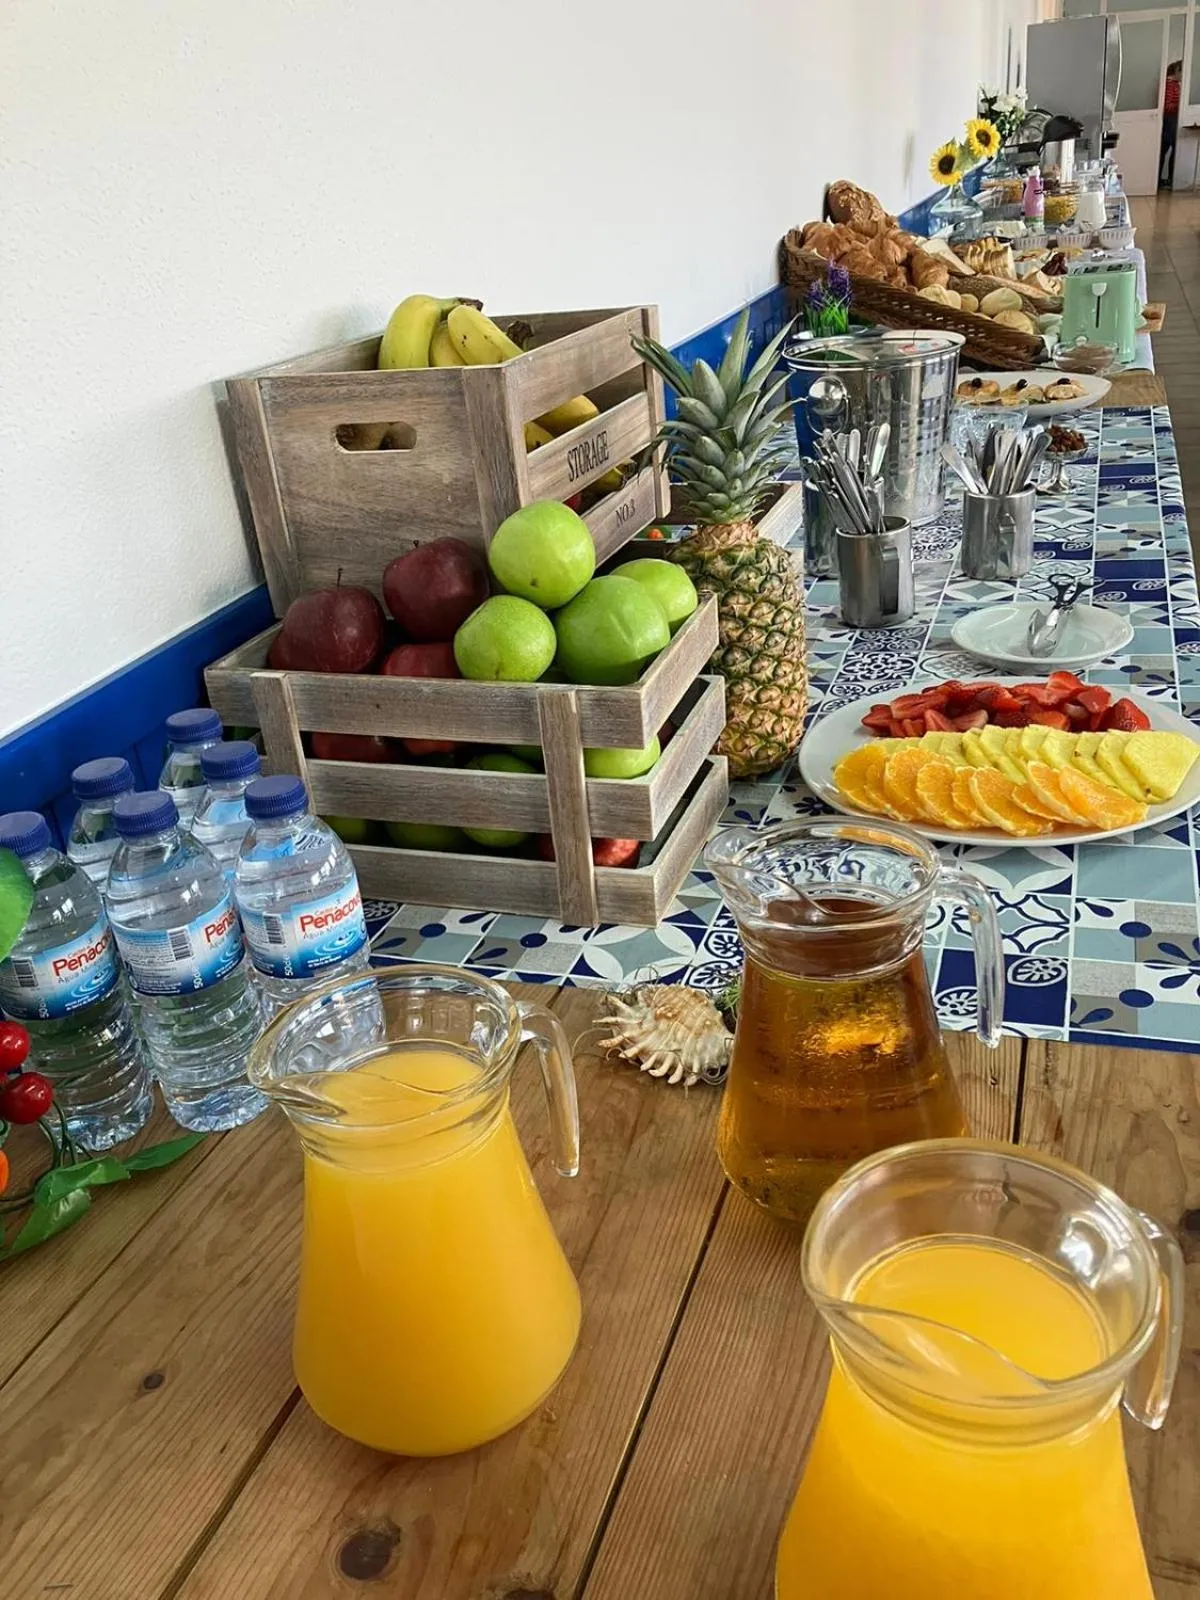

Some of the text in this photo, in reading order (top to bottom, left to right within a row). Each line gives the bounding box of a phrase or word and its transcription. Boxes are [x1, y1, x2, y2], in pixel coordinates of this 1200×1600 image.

[566, 430, 610, 482] STORAGE
[204, 908, 237, 942] Pena
[53, 930, 111, 977] Penaco
